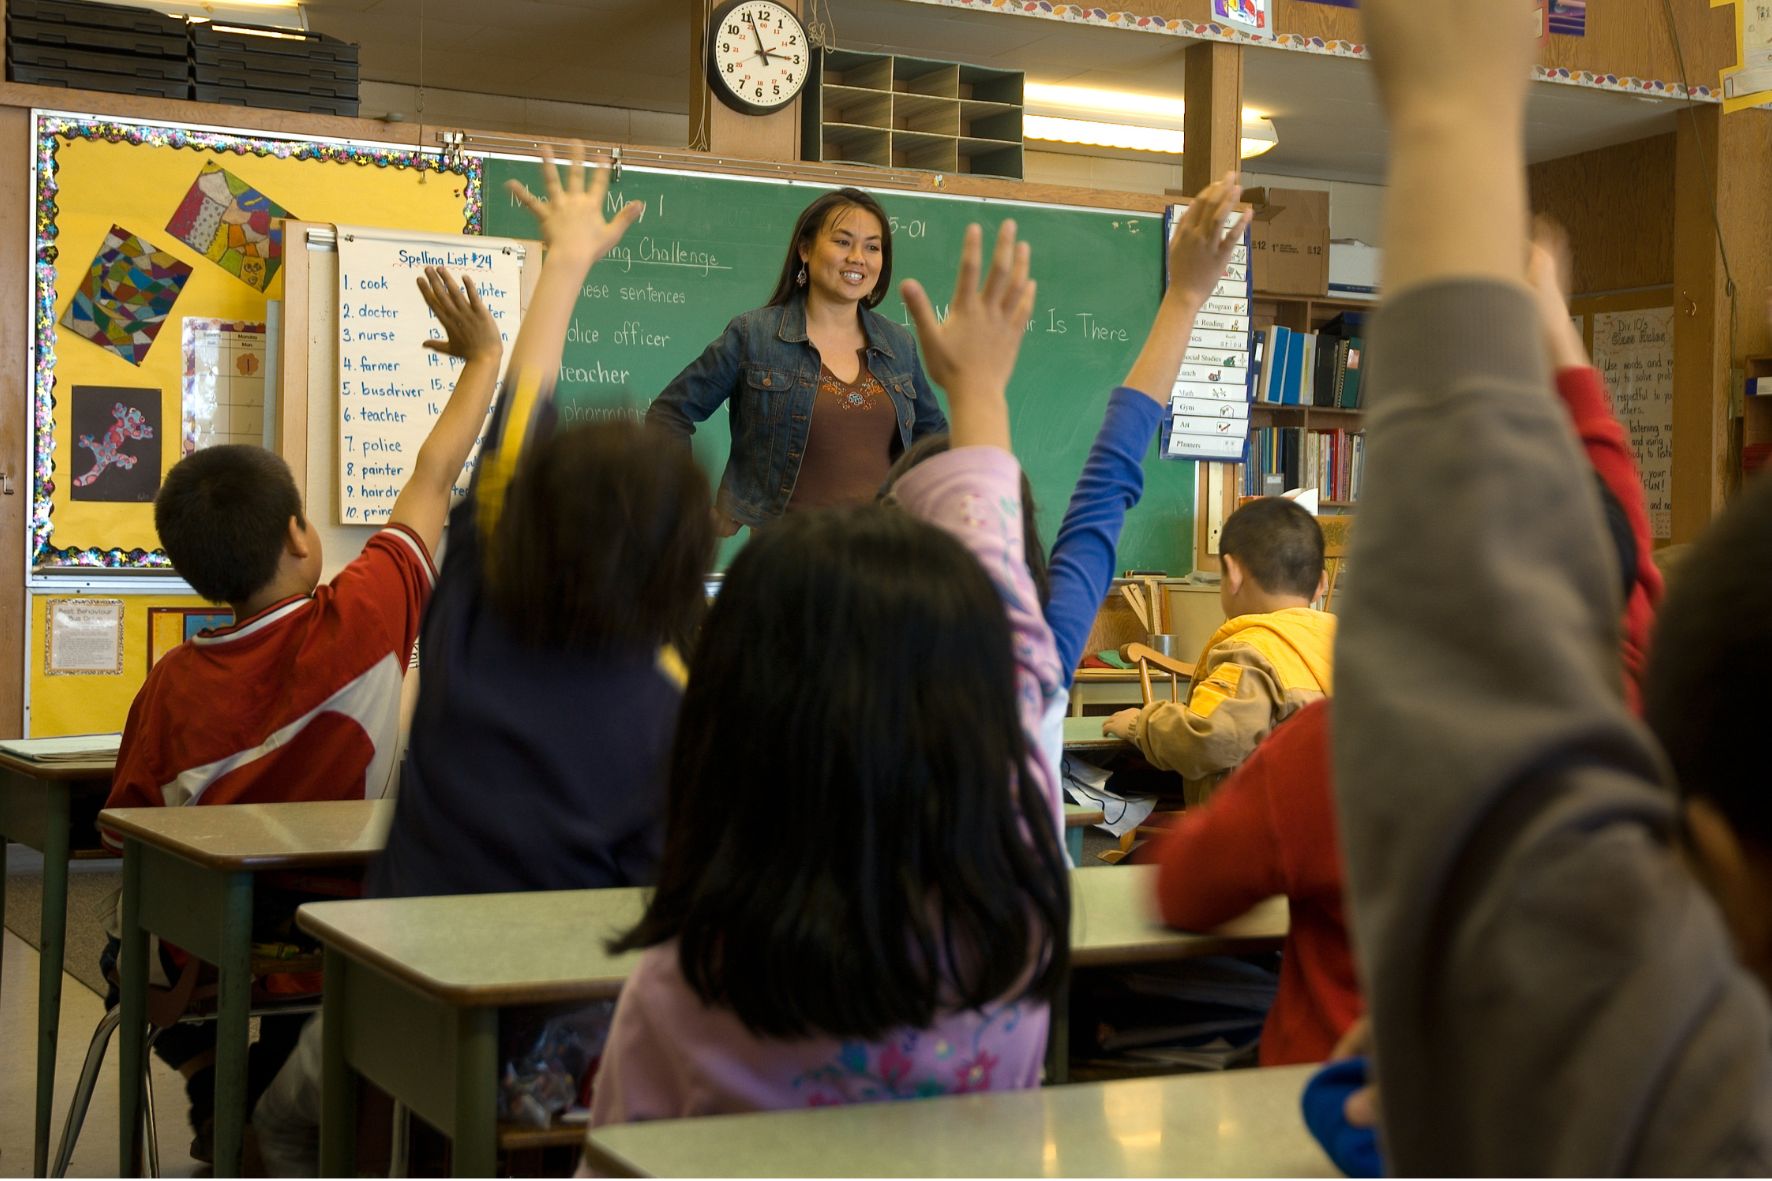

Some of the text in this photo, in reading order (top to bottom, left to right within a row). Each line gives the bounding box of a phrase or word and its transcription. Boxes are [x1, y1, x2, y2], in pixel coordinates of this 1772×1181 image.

[741, 12, 752, 23] 11
[758, 10, 770, 22] 12
[727, 24, 740, 35] 10
[778, 19, 783, 29] 1
[789, 35, 796, 45] 2
[723, 43, 730, 53] 9
[793, 55, 800, 65] 3
[727, 63, 734, 73] 8
[786, 73, 793, 83] 4
[739, 80, 745, 90] 7
[772, 85, 780, 95] 5
[755, 88, 762, 97] 6
[399, 249, 492, 269] Spelling List #24
[608, 236, 719, 278] ing Challenge
[360, 275, 388, 290] cook
[620, 282, 686, 304] sentences
[343, 304, 398, 319] 2. doctor
[1046, 308, 1068, 334] Is
[1075, 312, 1129, 342] There
[1201, 318, 1224, 328] Reading
[343, 328, 395, 342] 3. nurse
[567, 318, 671, 347] olice officer
[360, 355, 400, 372] farmer
[560, 360, 630, 384] teacher
[342, 381, 424, 398] 5. busdriver
[1179, 404, 1195, 412] Gym
[343, 407, 407, 423] 6. teacher
[363, 438, 402, 457] police
[362, 462, 404, 479] painter
